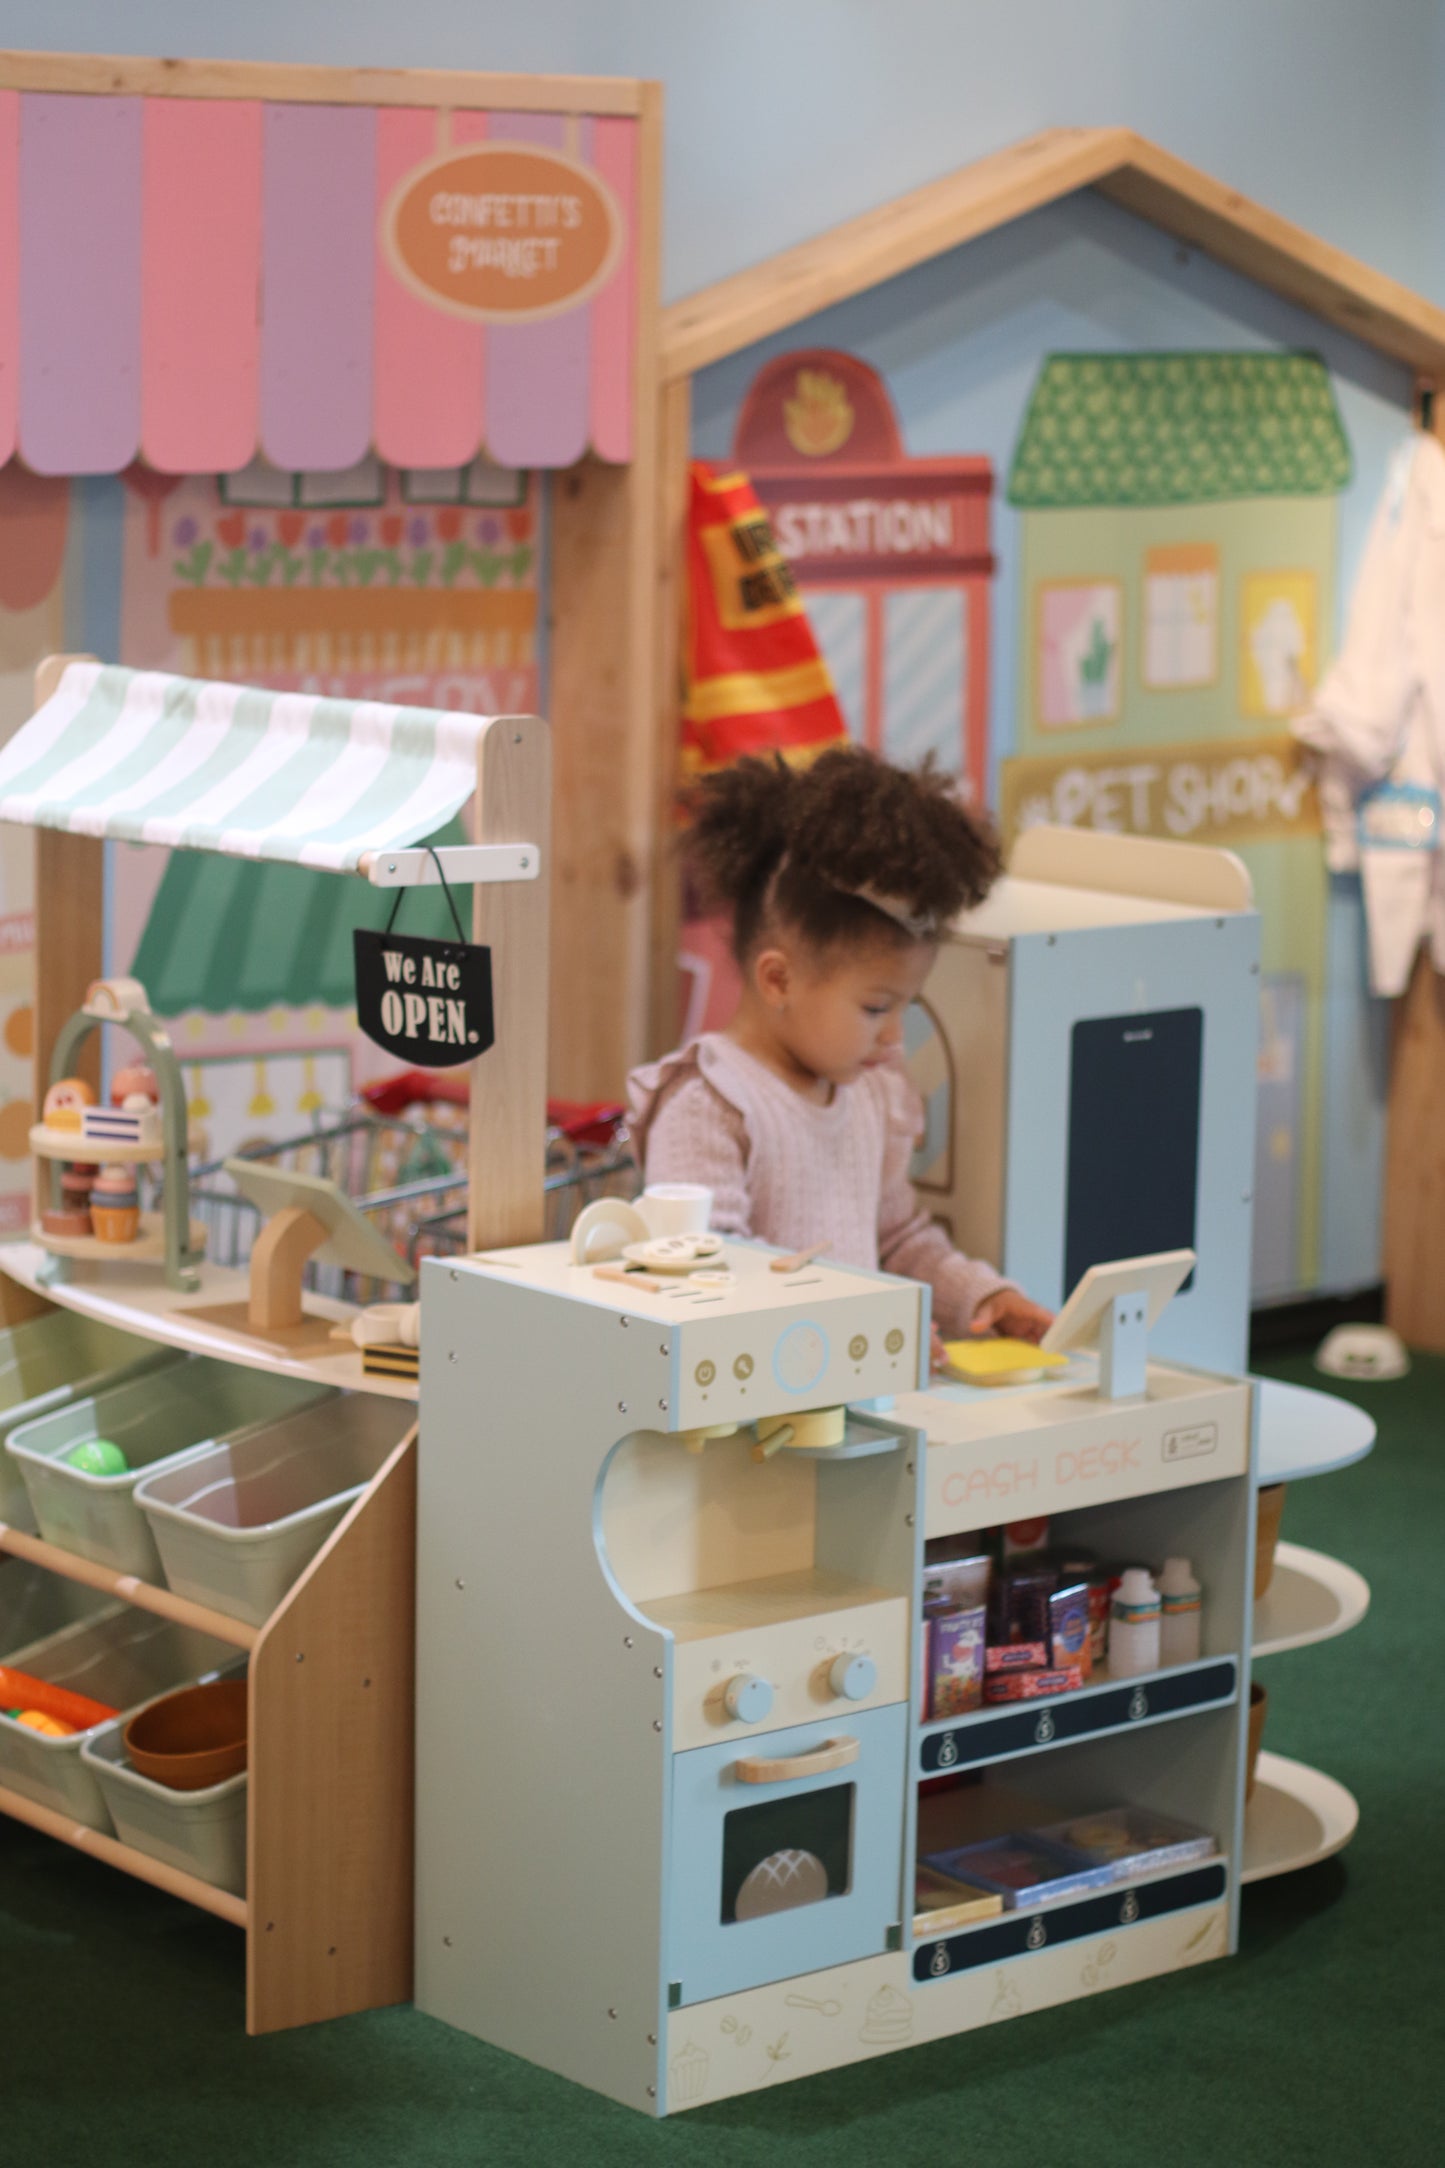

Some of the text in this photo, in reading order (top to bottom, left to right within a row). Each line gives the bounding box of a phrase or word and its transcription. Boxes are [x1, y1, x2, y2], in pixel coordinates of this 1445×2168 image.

[448, 235, 562, 279] MARKET
[776, 499, 949, 559] STATION
[1055, 754, 1284, 835] PET SHOP
[382, 951, 460, 990] We Are
[381, 990, 479, 1045] OPEN.
[941, 1438, 1143, 1507] CASH DESK
